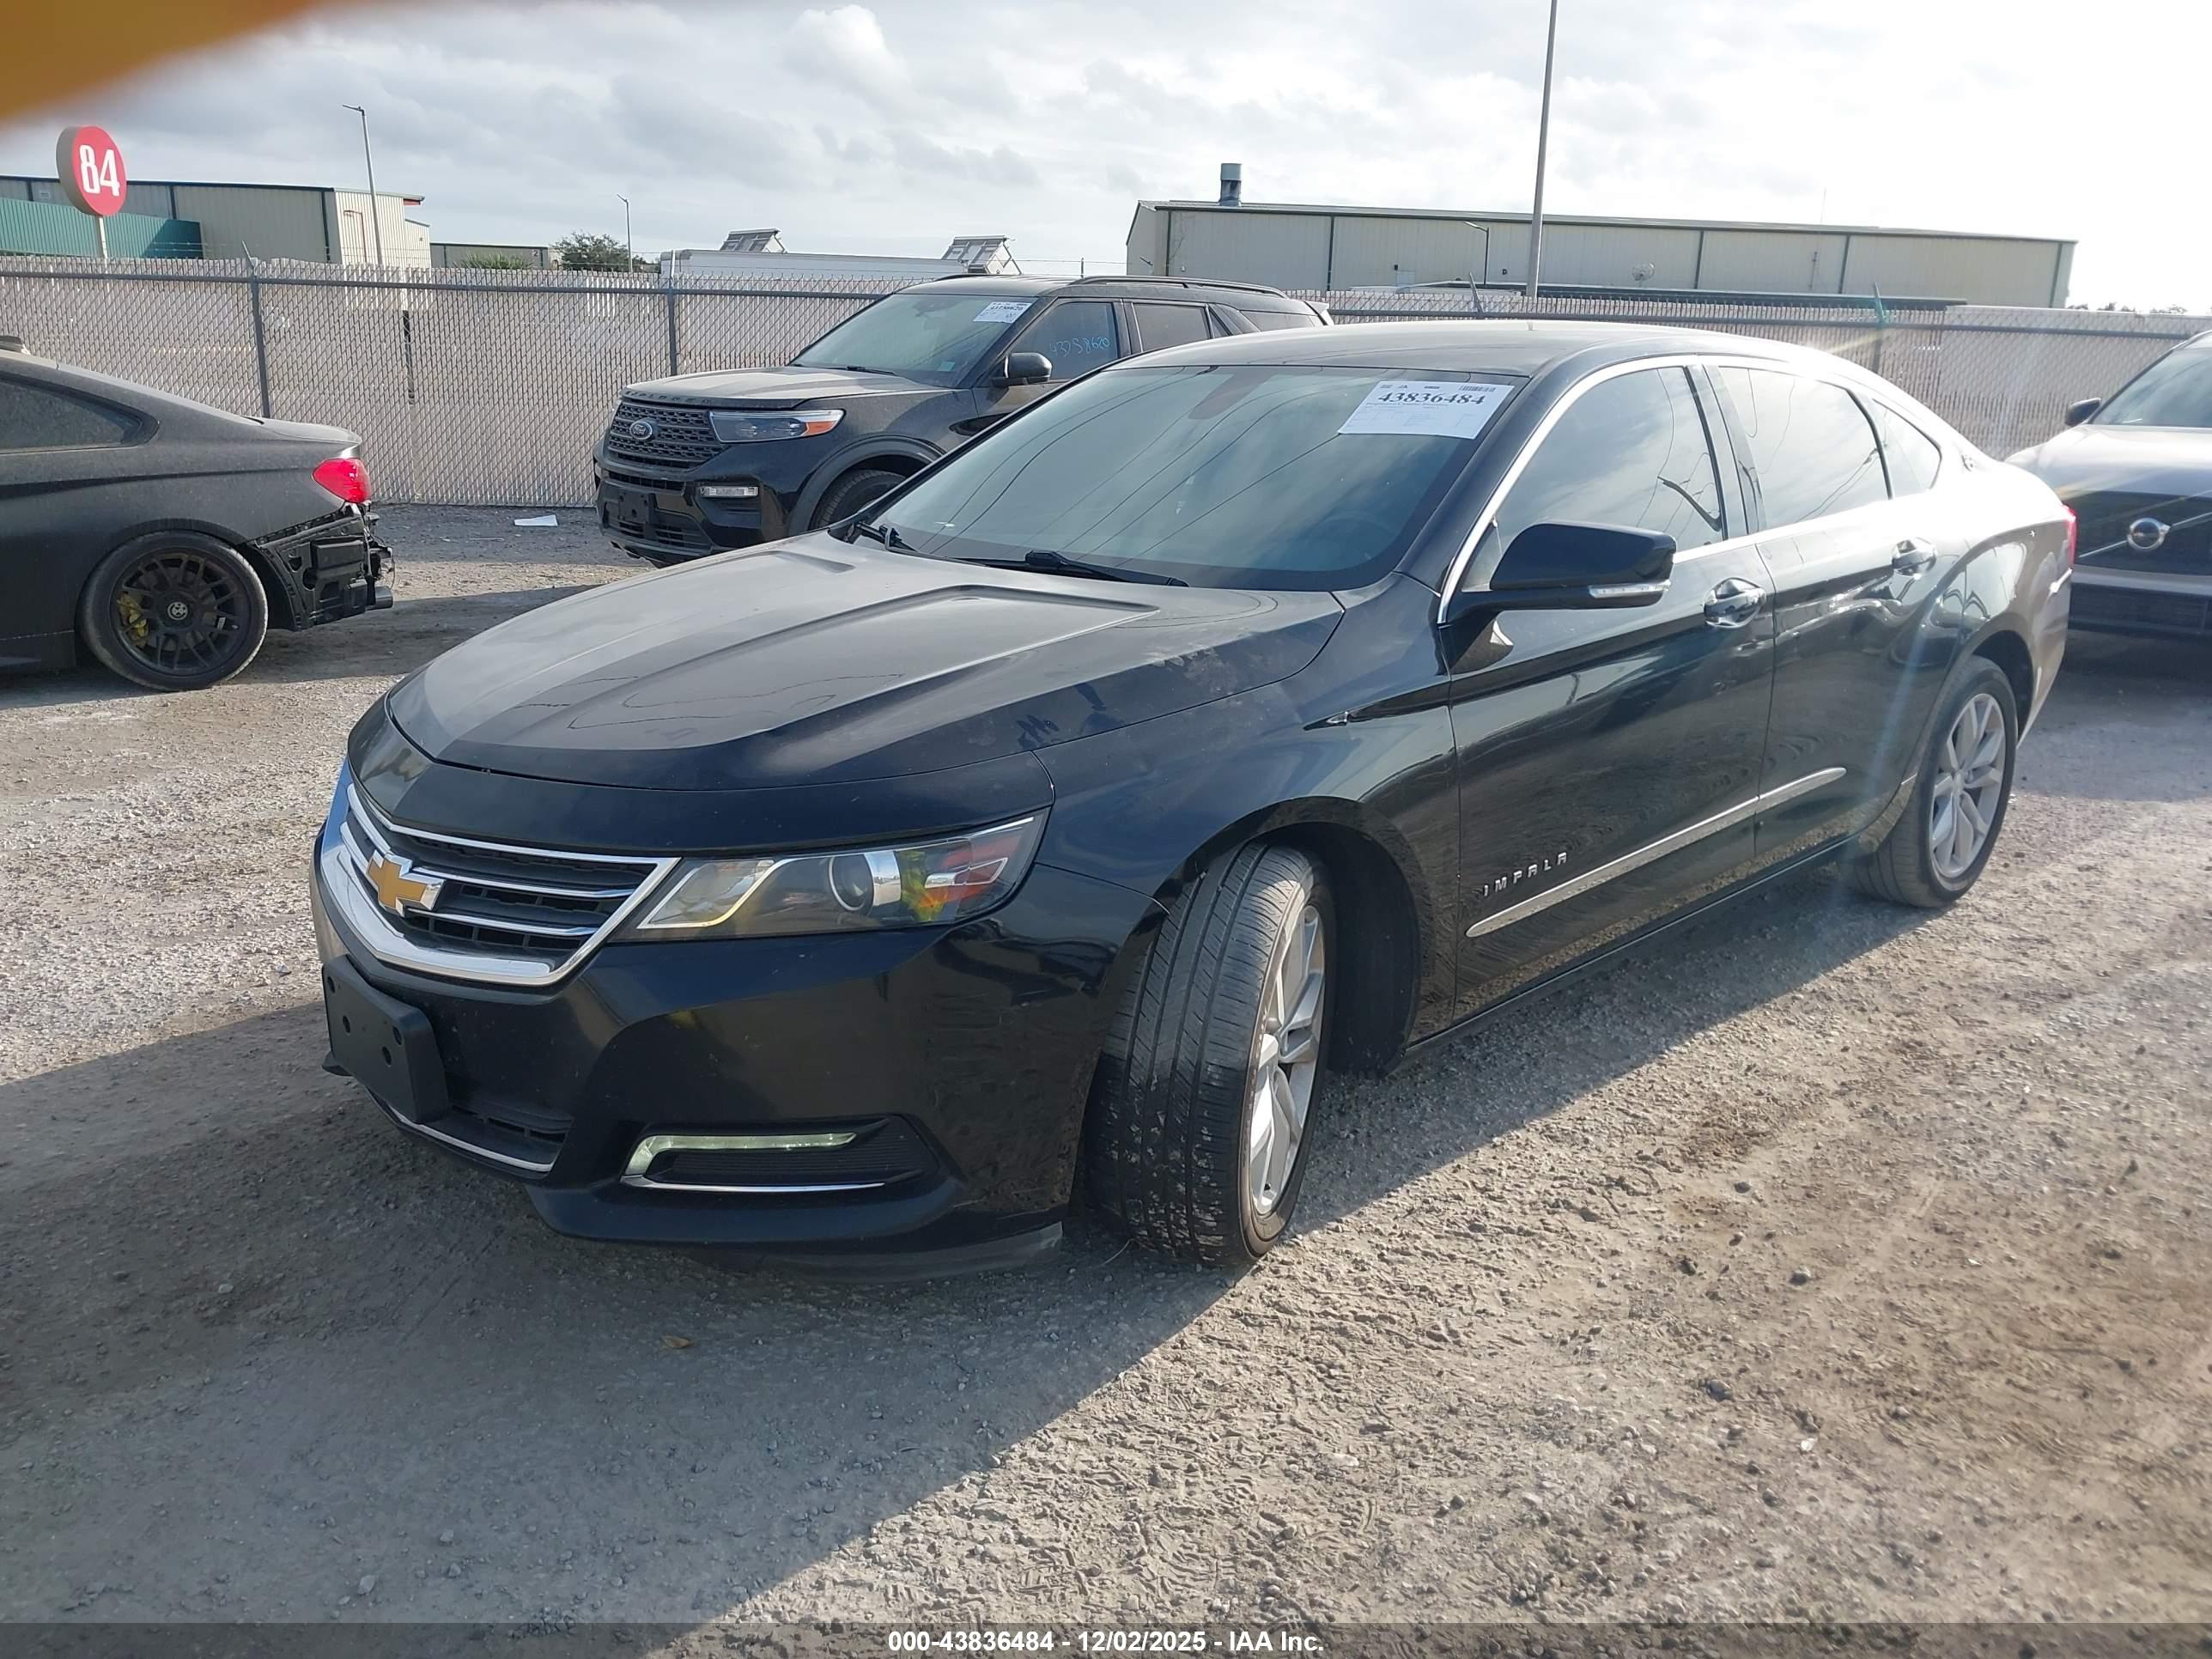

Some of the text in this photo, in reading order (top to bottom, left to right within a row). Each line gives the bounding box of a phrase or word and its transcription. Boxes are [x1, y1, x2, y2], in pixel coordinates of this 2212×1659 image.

[79, 144, 120, 197] 84
[1377, 392, 1486, 405] 43836484
[1483, 852, 1567, 896] IMPALA
